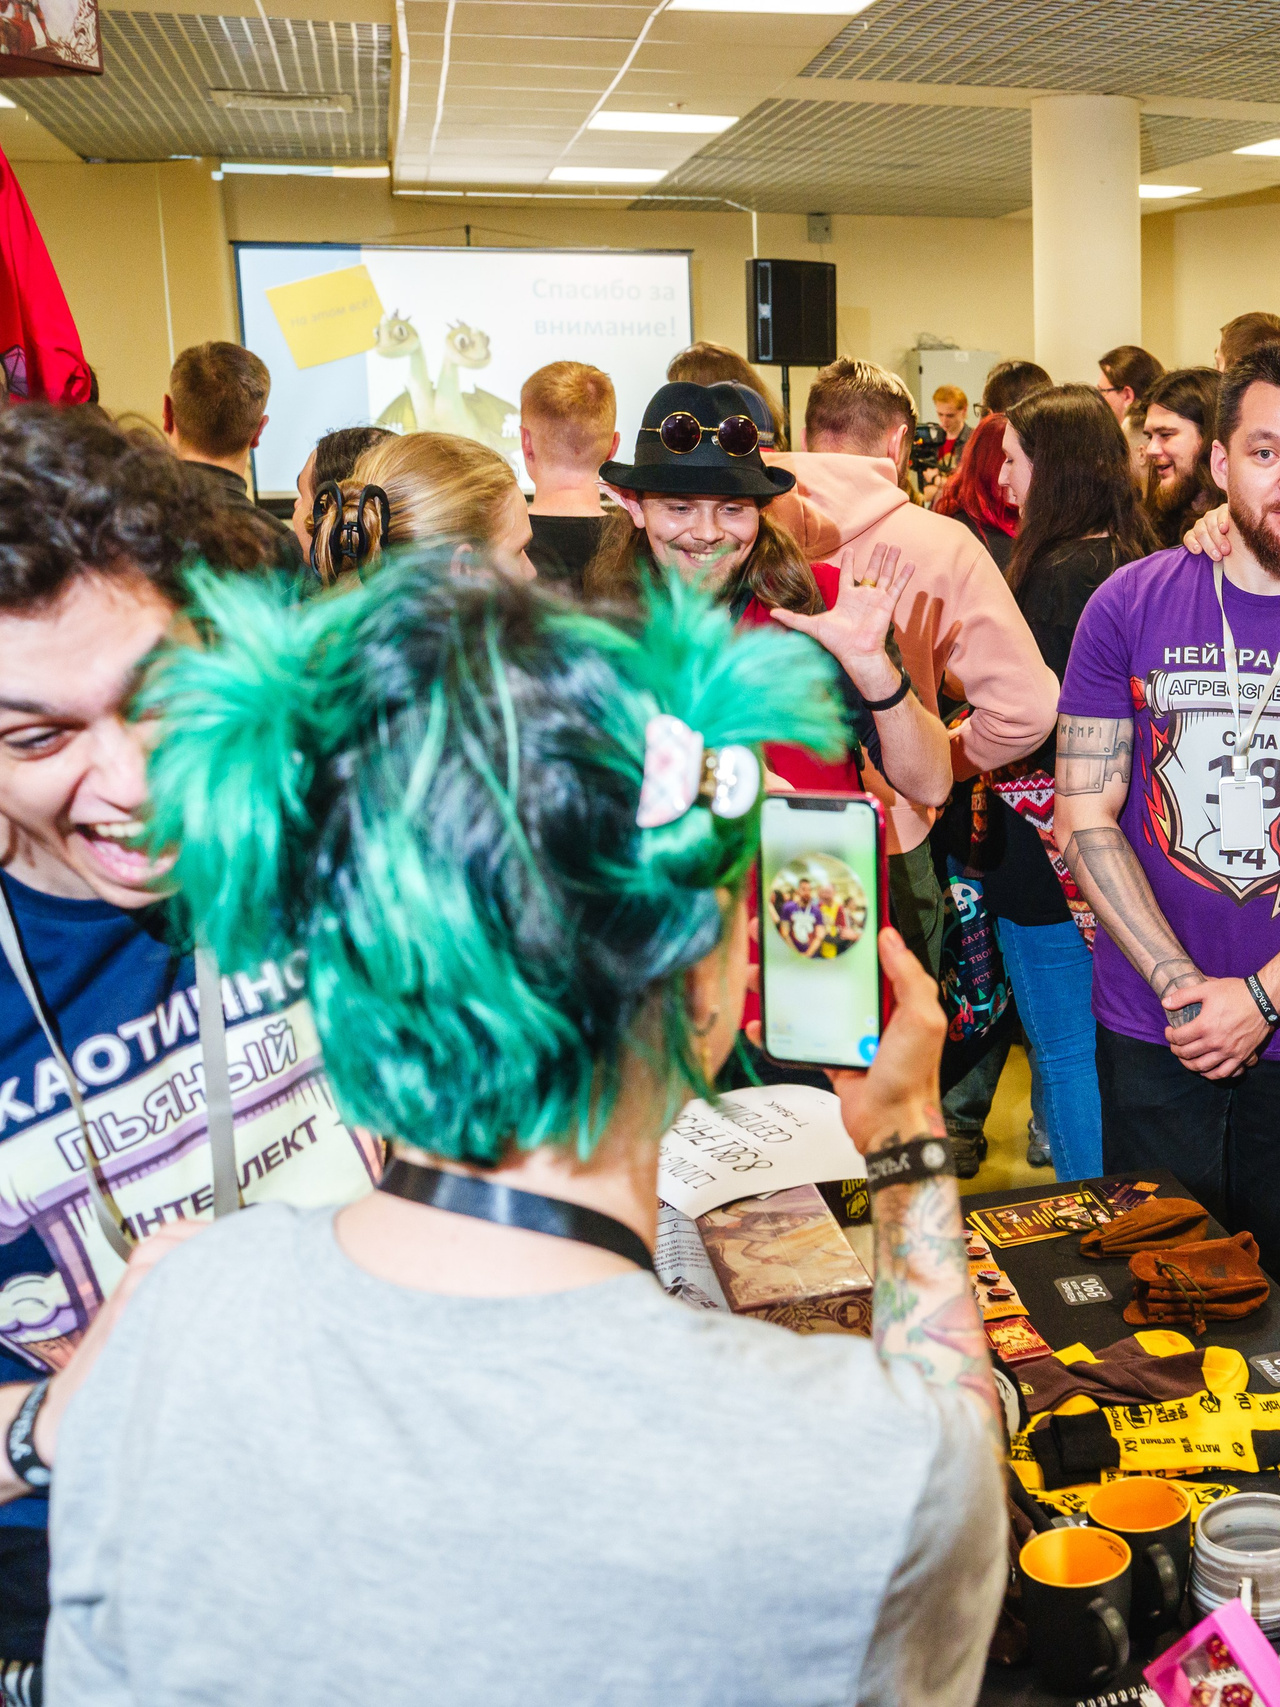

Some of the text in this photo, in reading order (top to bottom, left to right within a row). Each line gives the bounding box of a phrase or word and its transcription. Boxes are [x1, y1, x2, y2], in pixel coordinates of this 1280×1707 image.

[532, 278, 675, 300] Спасибо за
[534, 316, 676, 336] внимание!
[1221, 730, 1279, 750] СЛА
[971, 969, 993, 986] ИСТ
[55, 1017, 298, 1173] ПЬЯНЫЙ
[126, 1114, 319, 1243] НТЕЛЕКТ
